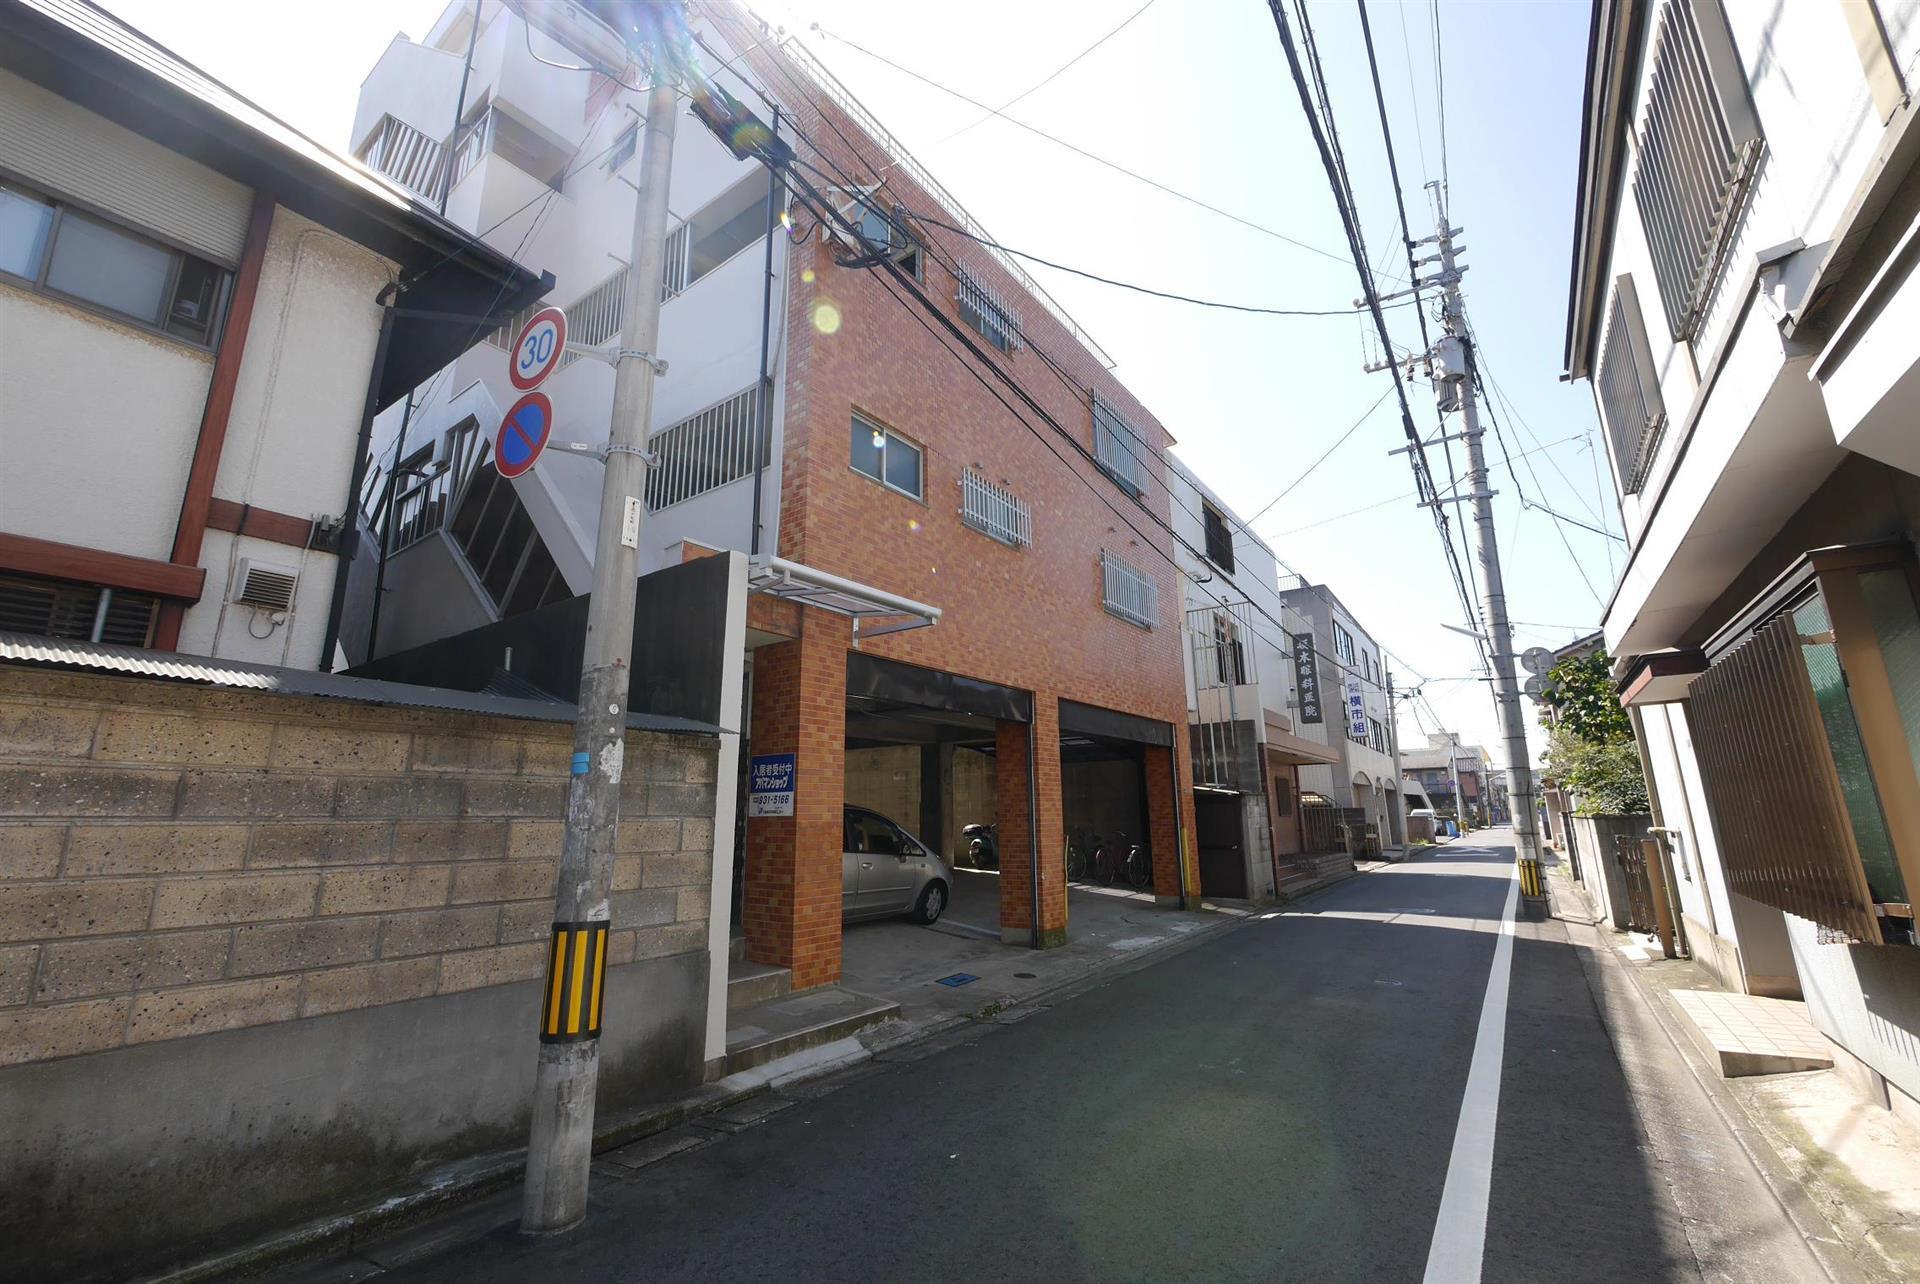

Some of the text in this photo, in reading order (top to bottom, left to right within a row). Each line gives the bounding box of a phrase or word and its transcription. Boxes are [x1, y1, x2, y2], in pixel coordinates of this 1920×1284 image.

[521, 329, 554, 369] 30
[753, 763, 792, 777] 入居者受付中
